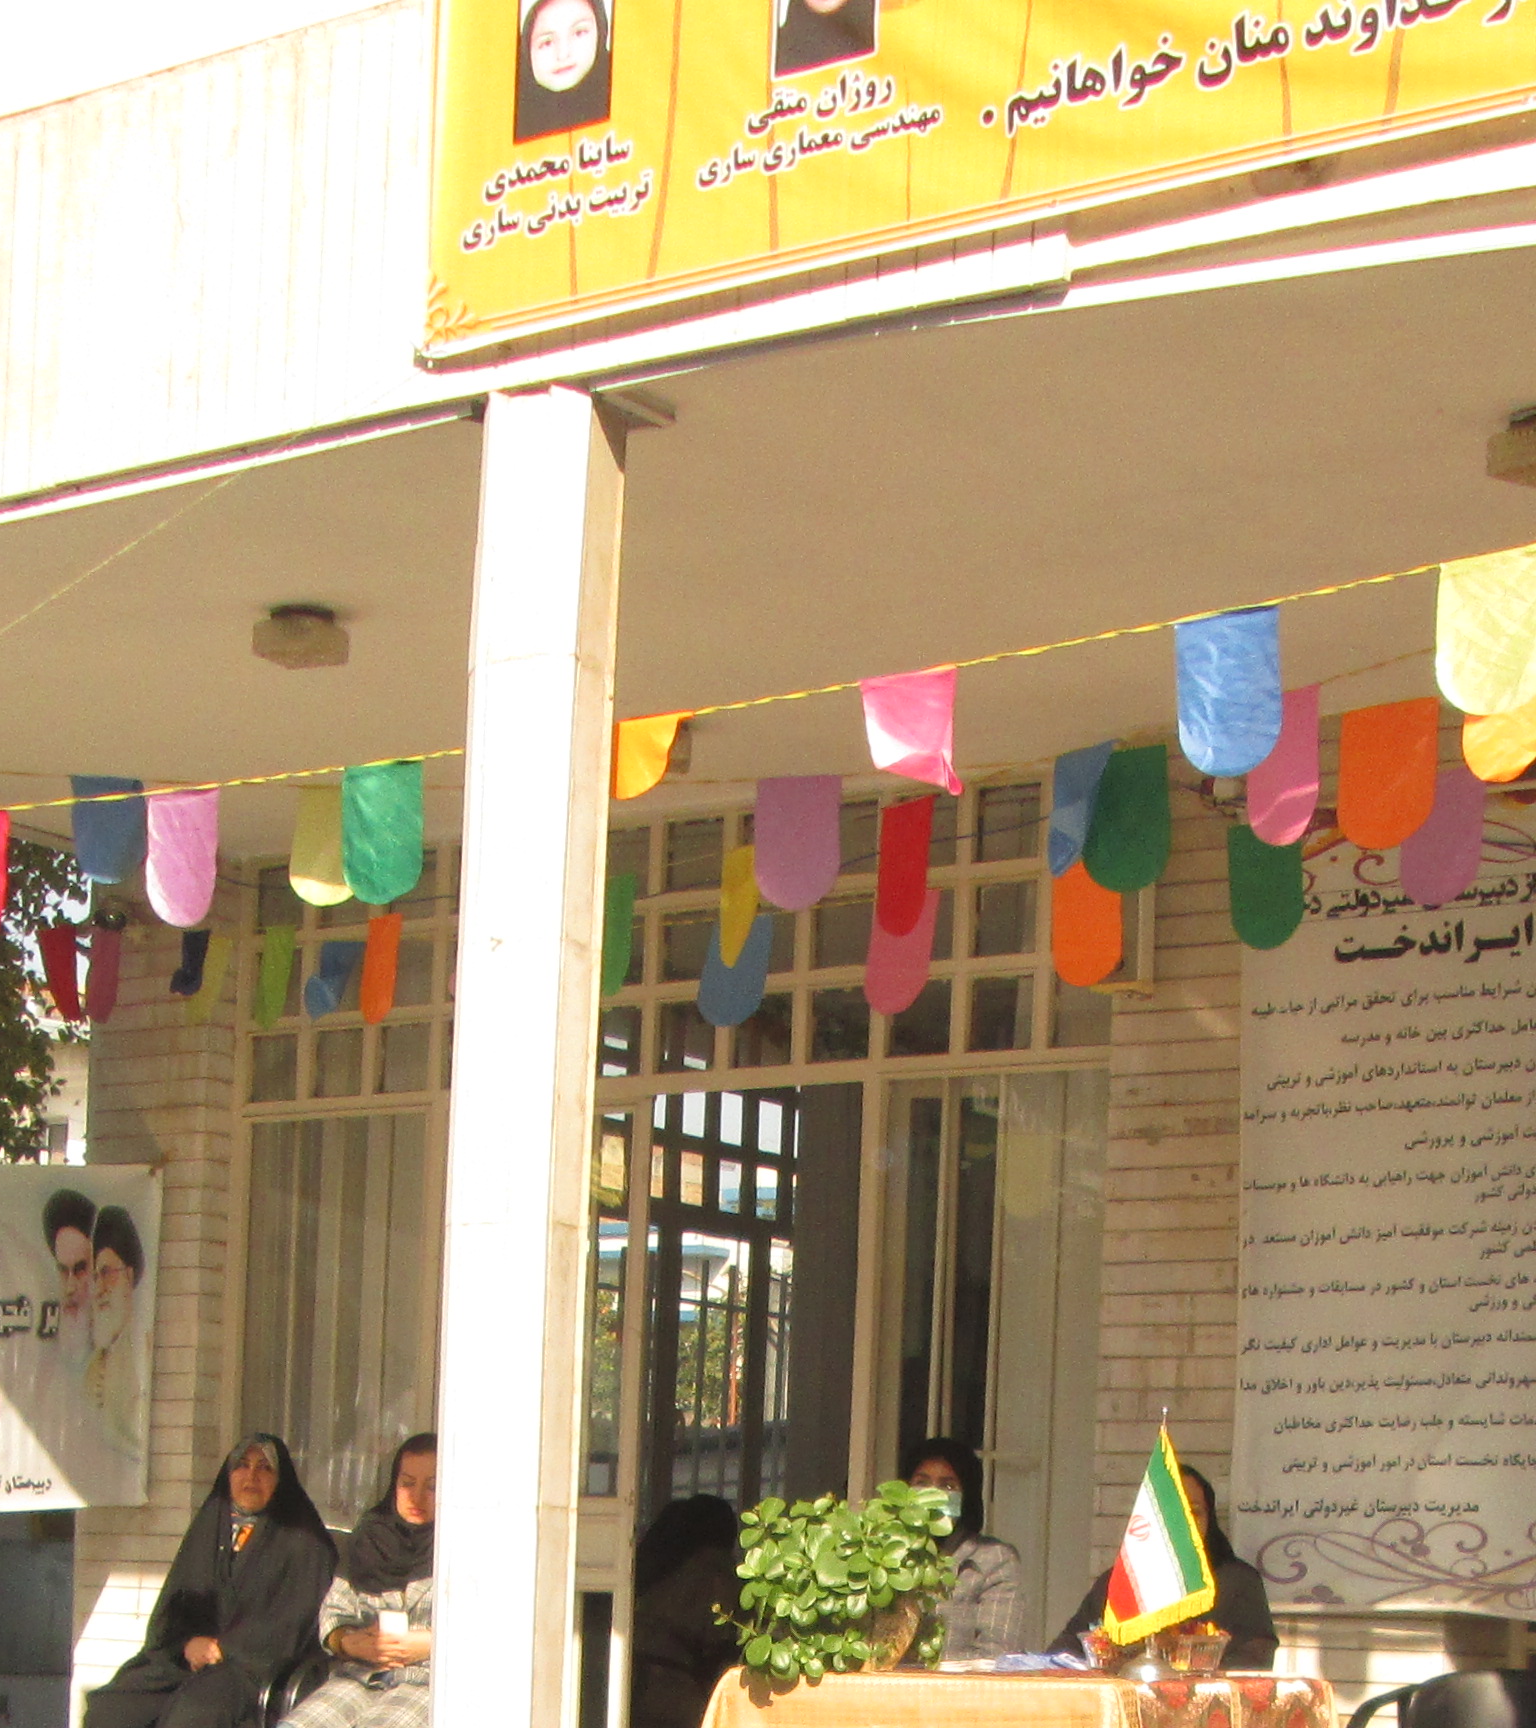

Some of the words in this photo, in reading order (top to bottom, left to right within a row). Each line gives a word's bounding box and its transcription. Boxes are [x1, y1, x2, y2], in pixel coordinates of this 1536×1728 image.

[1305, 0, 1463, 52] داوند
[1197, 14, 1291, 89] منان
[816, 73, 893, 118] روژان
[1006, 36, 1185, 136] خواهانیم
[747, 91, 808, 135] متقی
[850, 106, 941, 151] مهندسی
[578, 134, 631, 176] ساینا
[698, 147, 756, 187] ساری
[762, 131, 843, 172] معماری
[484, 156, 571, 202] محمدی
[589, 172, 651, 214] تربیت
[462, 207, 520, 250] ساری
[526, 194, 582, 235] بدنی
[1333, 911, 1535, 964] ایراندخت
[1462, 1057, 1521, 1076] دبیرستان
[37, 1299, 61, 1339] بر
[1237, 1499, 1300, 1519] ایراندخت
[1364, 1499, 1420, 1518] دبیرستان
[1424, 1500, 1479, 1518] مدیریت
